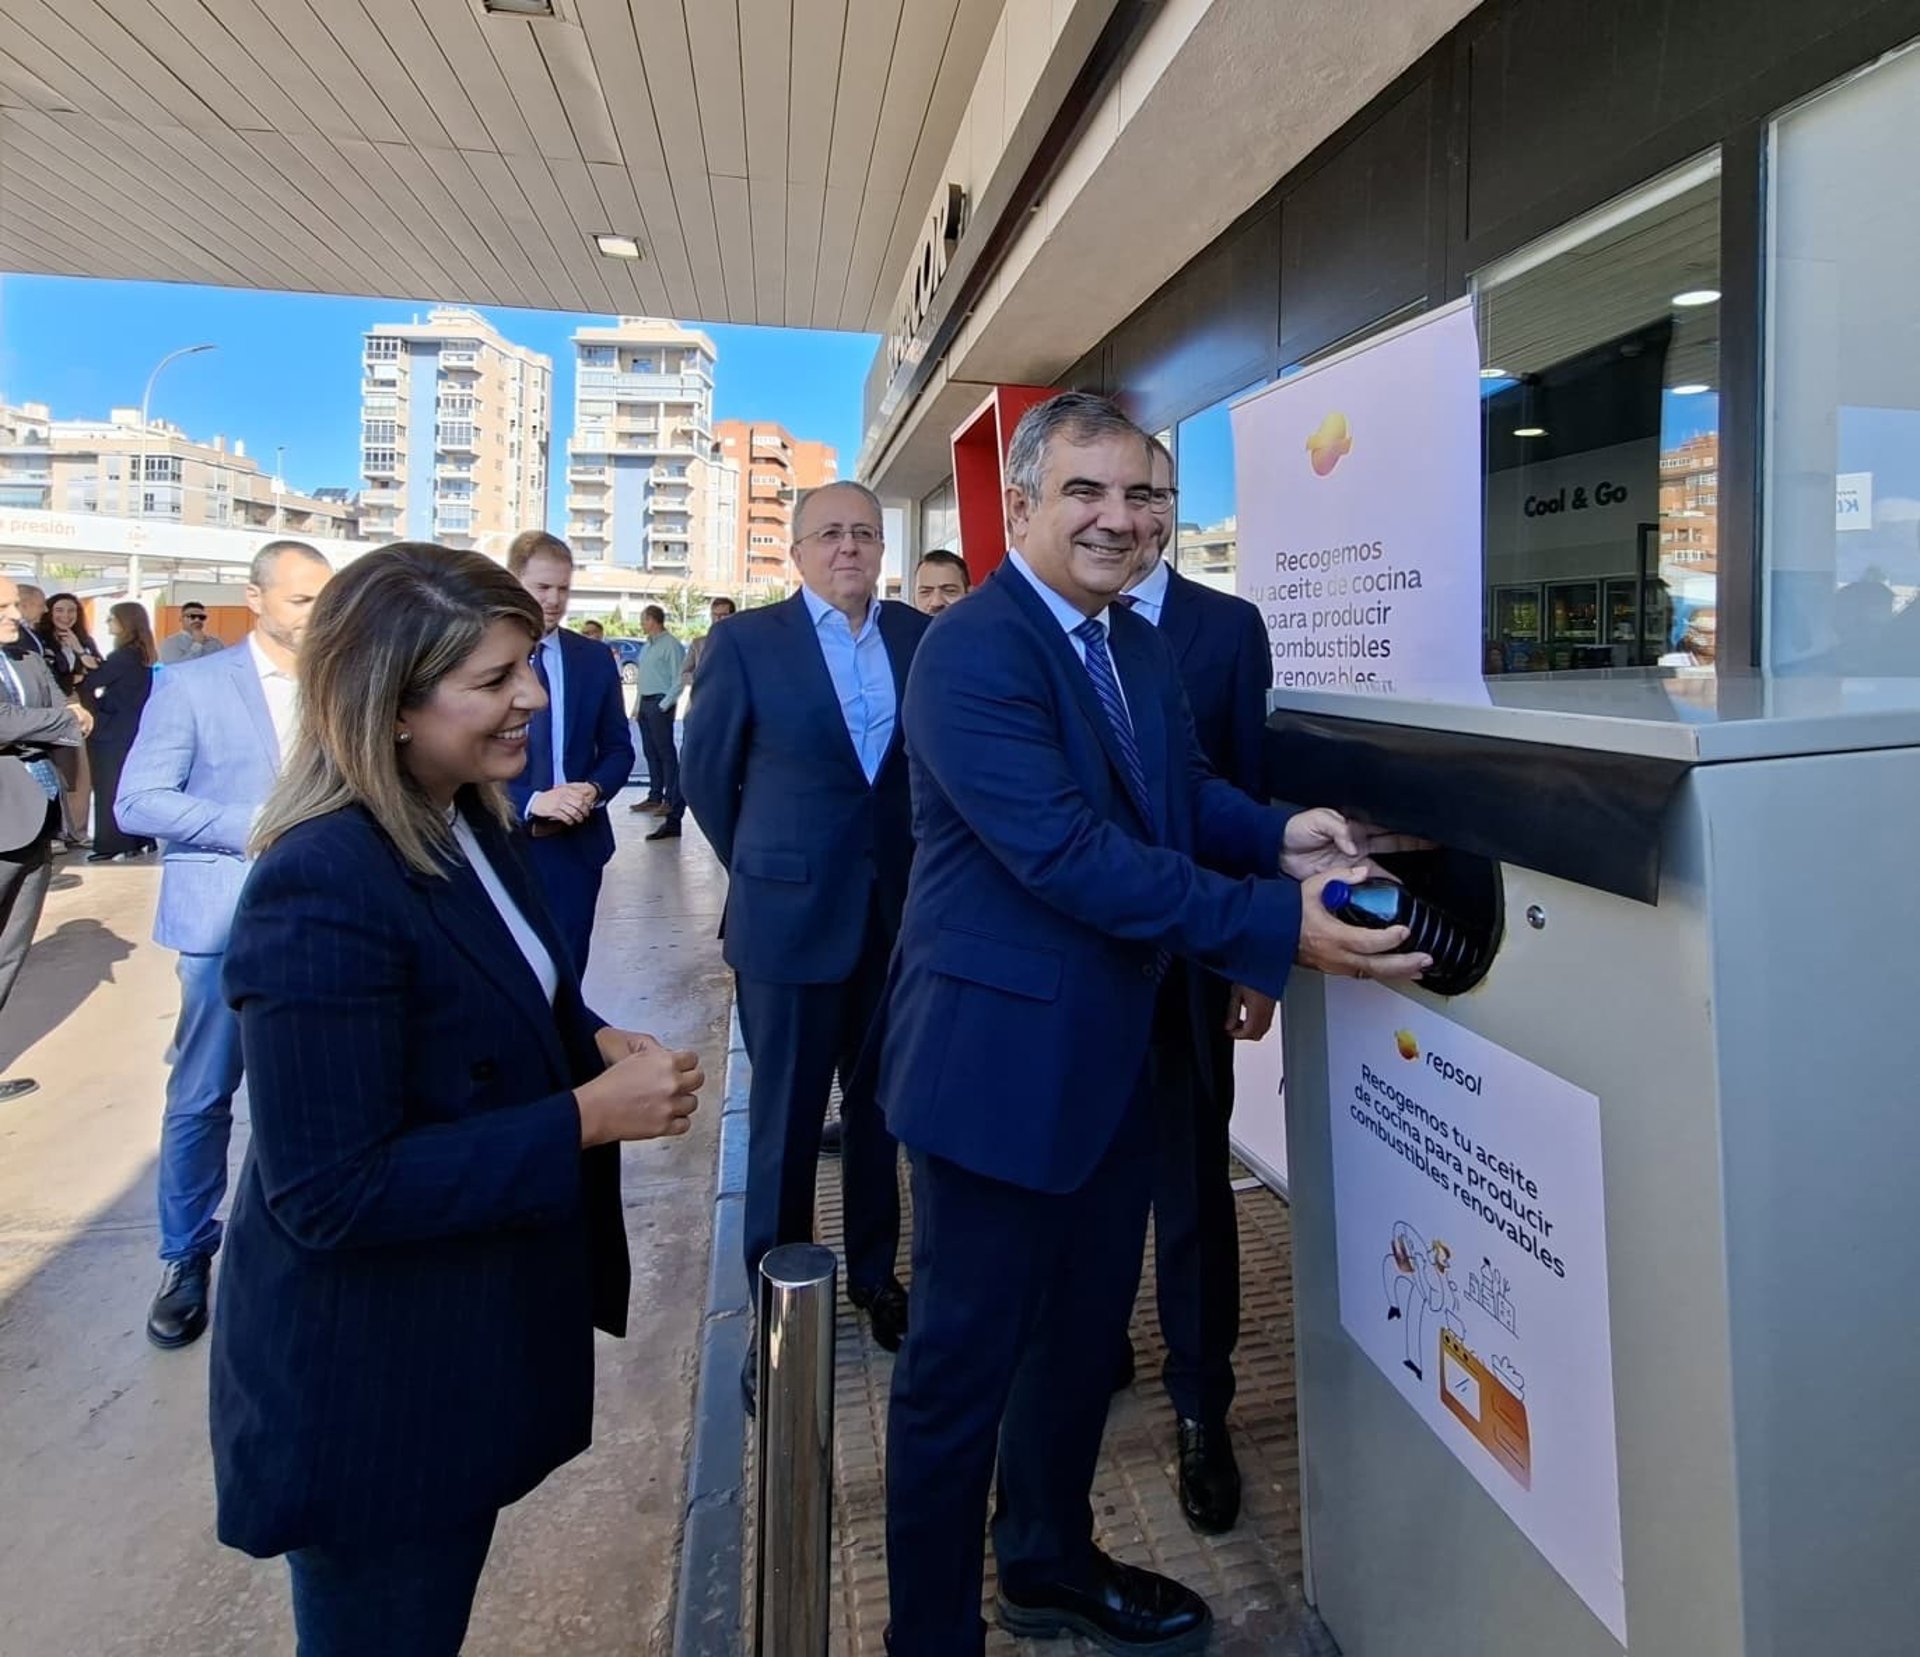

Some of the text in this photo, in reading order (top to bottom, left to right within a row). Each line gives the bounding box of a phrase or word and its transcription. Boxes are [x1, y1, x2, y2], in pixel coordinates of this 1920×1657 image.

[1524, 481, 1627, 517] Cool & Go
[10, 519, 76, 536] presión
[1275, 541, 1382, 572] Recogemos
[1267, 577, 1323, 601] aceite
[1327, 575, 1348, 596] de
[1352, 566, 1422, 594] cocina
[1266, 600, 1391, 633] para producir
[1271, 634, 1391, 658] ombustibles
[1426, 1051, 1482, 1096] repsol
[1361, 1063, 1539, 1200] Recogemos tu aceite
[1354, 1084, 1553, 1238] de cocina para producir
[1350, 1104, 1566, 1279] combustibles renovables
